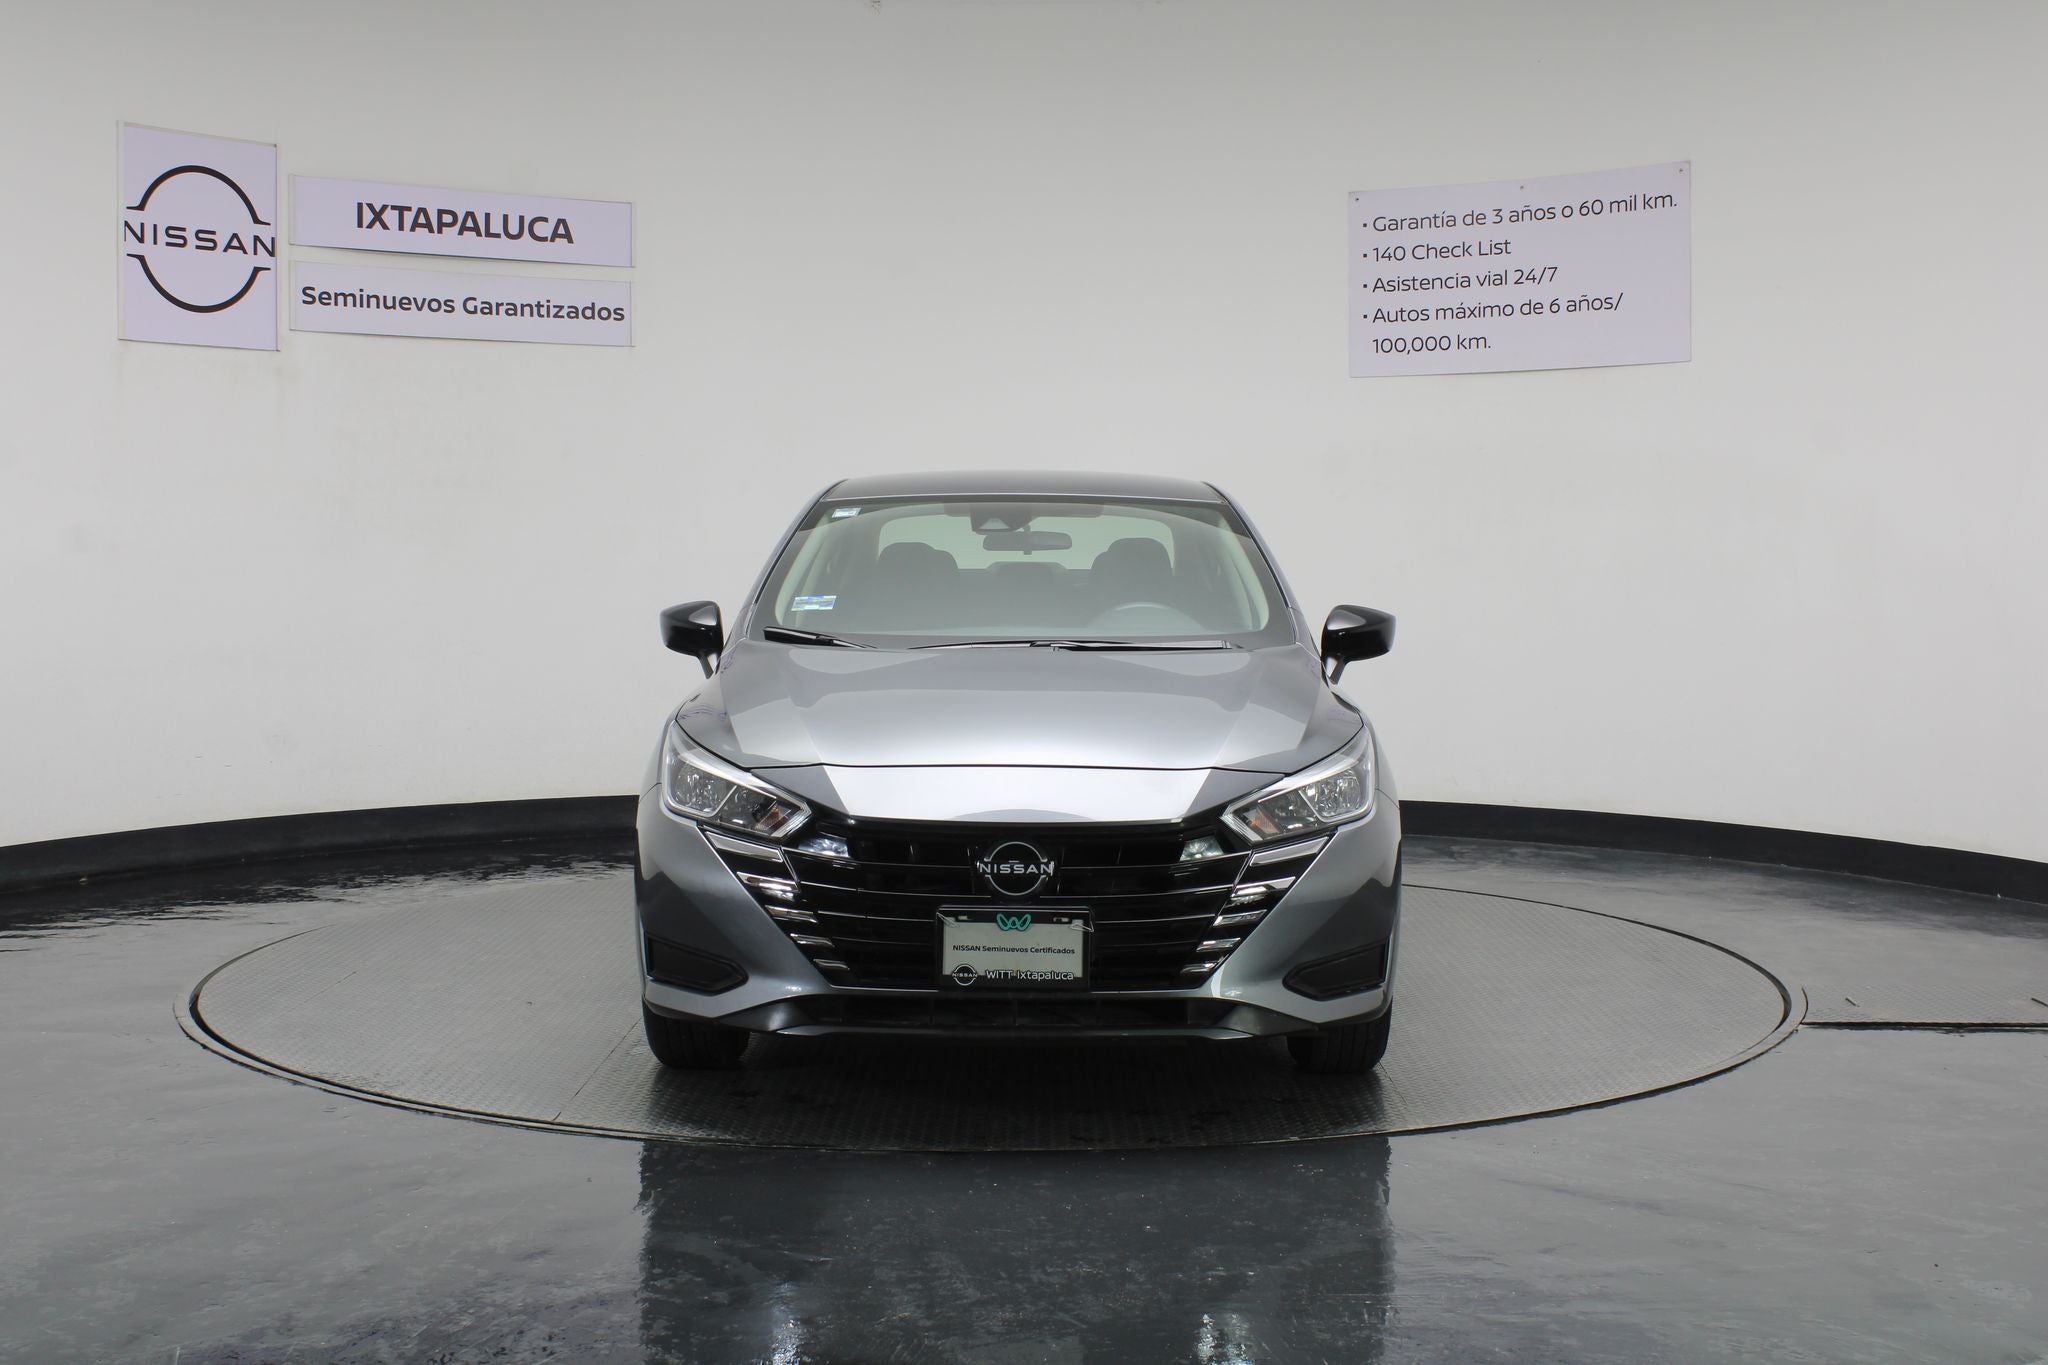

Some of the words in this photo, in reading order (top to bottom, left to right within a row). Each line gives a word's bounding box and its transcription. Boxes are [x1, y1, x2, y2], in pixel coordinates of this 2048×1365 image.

[356, 202, 574, 245] IXTAPALUCA
[1372, 211, 1457, 232] Garantía
[1462, 209, 1487, 226] de
[1492, 207, 1503, 224] 3
[1508, 203, 1556, 222] años
[1561, 204, 1574, 218] o
[1578, 199, 1604, 217] 60
[1609, 195, 1638, 214] mil
[1642, 193, 1678, 210] km.
[124, 219, 276, 258] NISSAN
[1372, 245, 1406, 262] 140
[1411, 241, 1473, 261] Check
[1478, 239, 1512, 257] List
[1372, 271, 1472, 293] Asistencia
[1476, 269, 1509, 288] vial
[1513, 266, 1558, 286] 24/7
[301, 286, 457, 314] Seminuevos
[462, 296, 626, 322] Garantizados
[1372, 305, 1430, 324] Autos
[1435, 301, 1515, 321] máximo
[1519, 298, 1544, 316] de
[1549, 297, 1561, 315] 6
[1566, 292, 1624, 313] años/
[1372, 334, 1452, 355] 100,000
[1456, 333, 1492, 351] km.
[979, 864, 1053, 874] NISSAN
[952, 944, 981, 952] NISSAN
[982, 945, 1029, 953] Seminuevos
[1029, 946, 1076, 955] Certificados
[1017, 970, 1074, 982] Ixtapaluca
